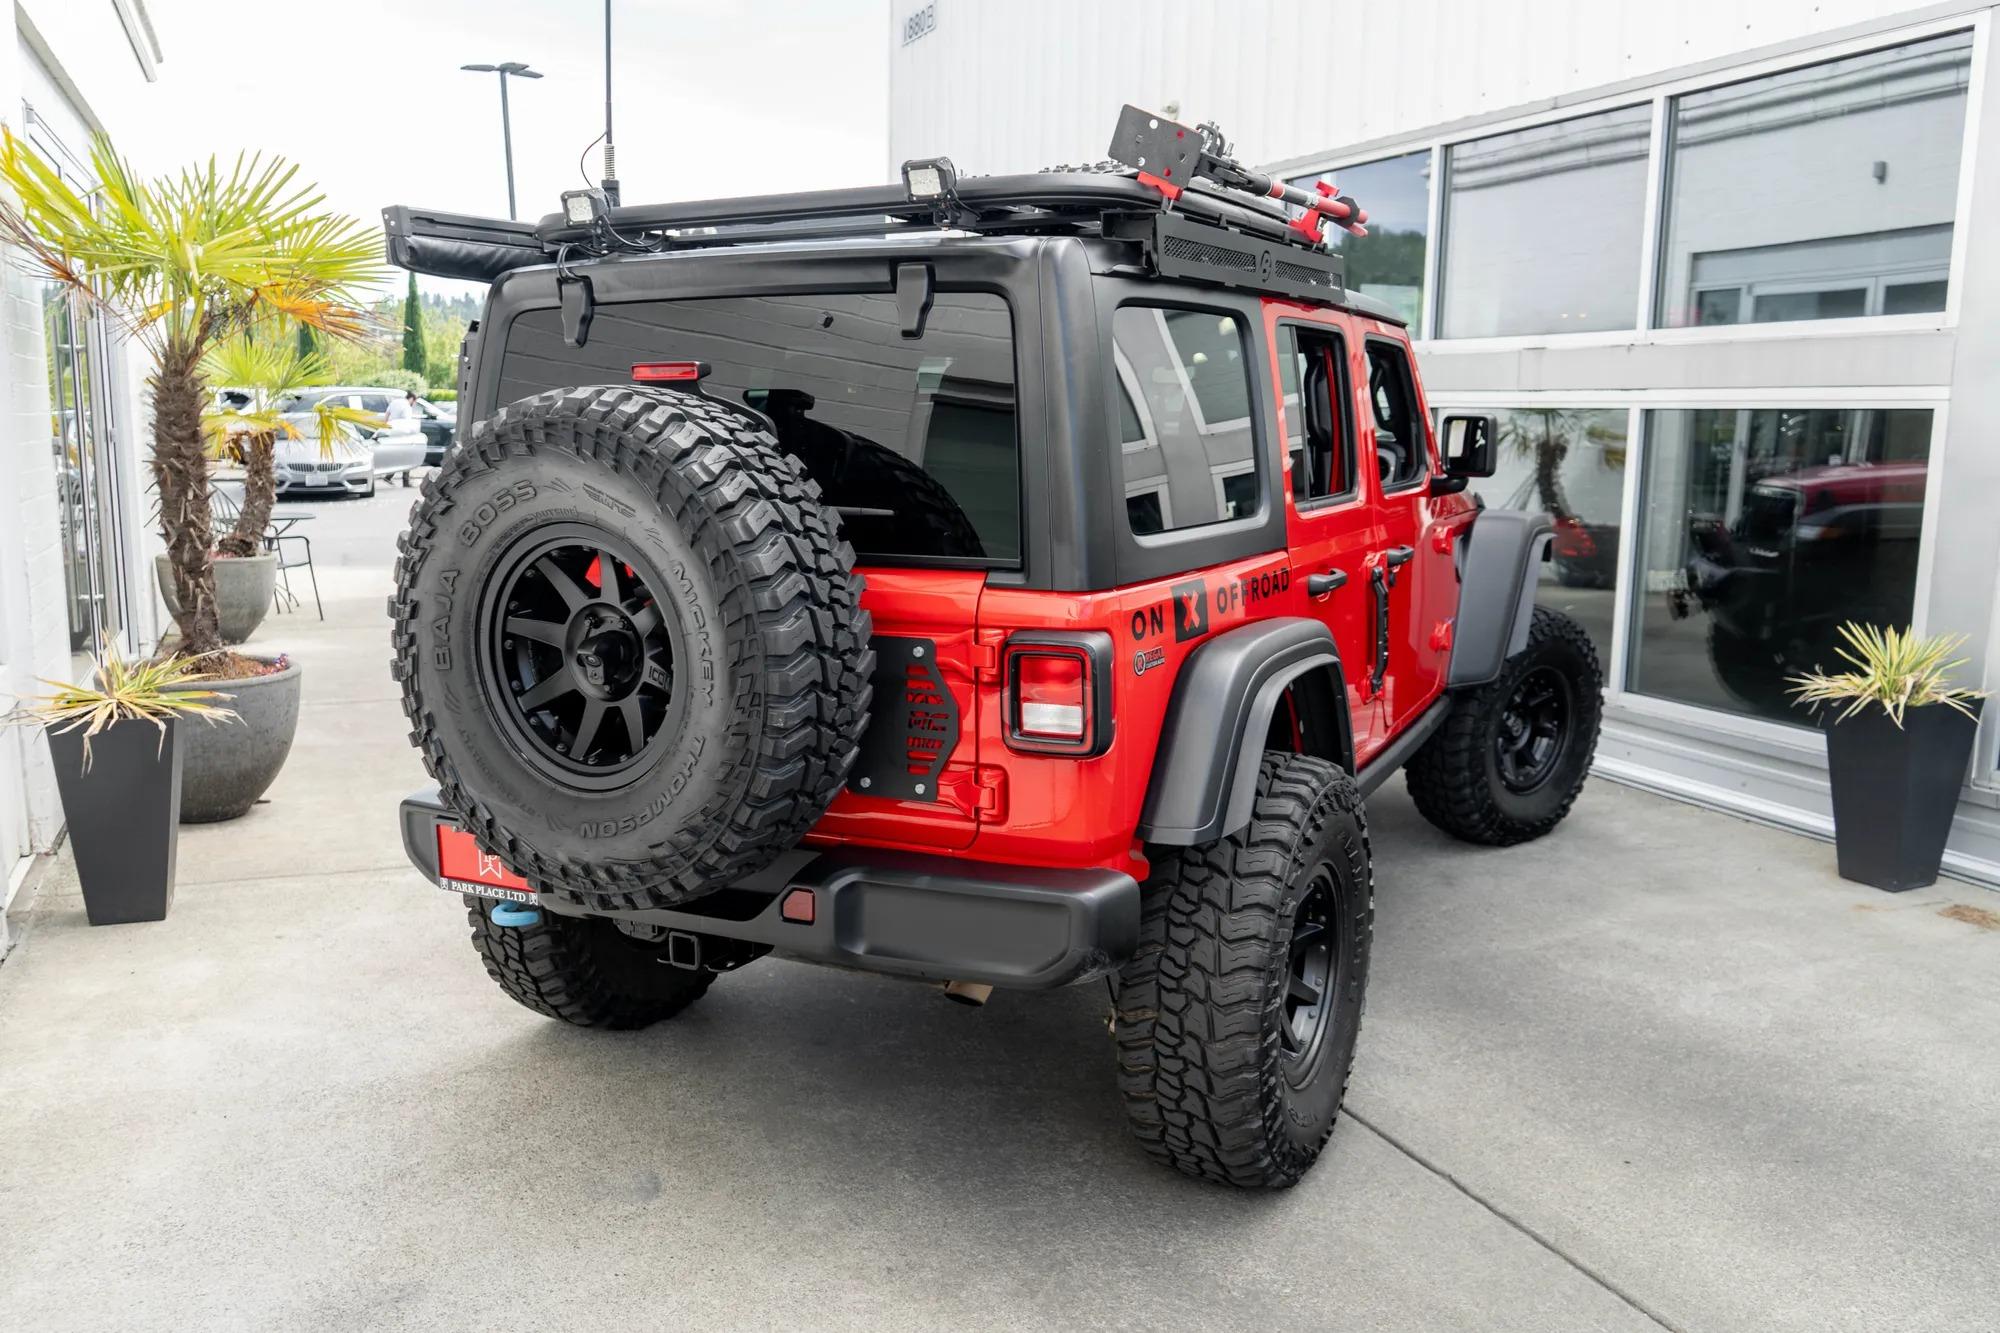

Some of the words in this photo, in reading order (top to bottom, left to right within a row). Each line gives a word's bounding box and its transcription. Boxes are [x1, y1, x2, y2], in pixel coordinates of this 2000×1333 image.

[432, 568, 461, 671] BAJA
[458, 479, 538, 547] BOSS
[1131, 603, 1164, 641] ON
[1216, 566, 1290, 614] OFFROAD
[670, 560, 715, 708] MICKEY
[579, 735, 706, 840] THOMPSON
[451, 881, 475, 894] PARK
[475, 885, 506, 899] PLACE
[506, 890, 526, 902] LTD
